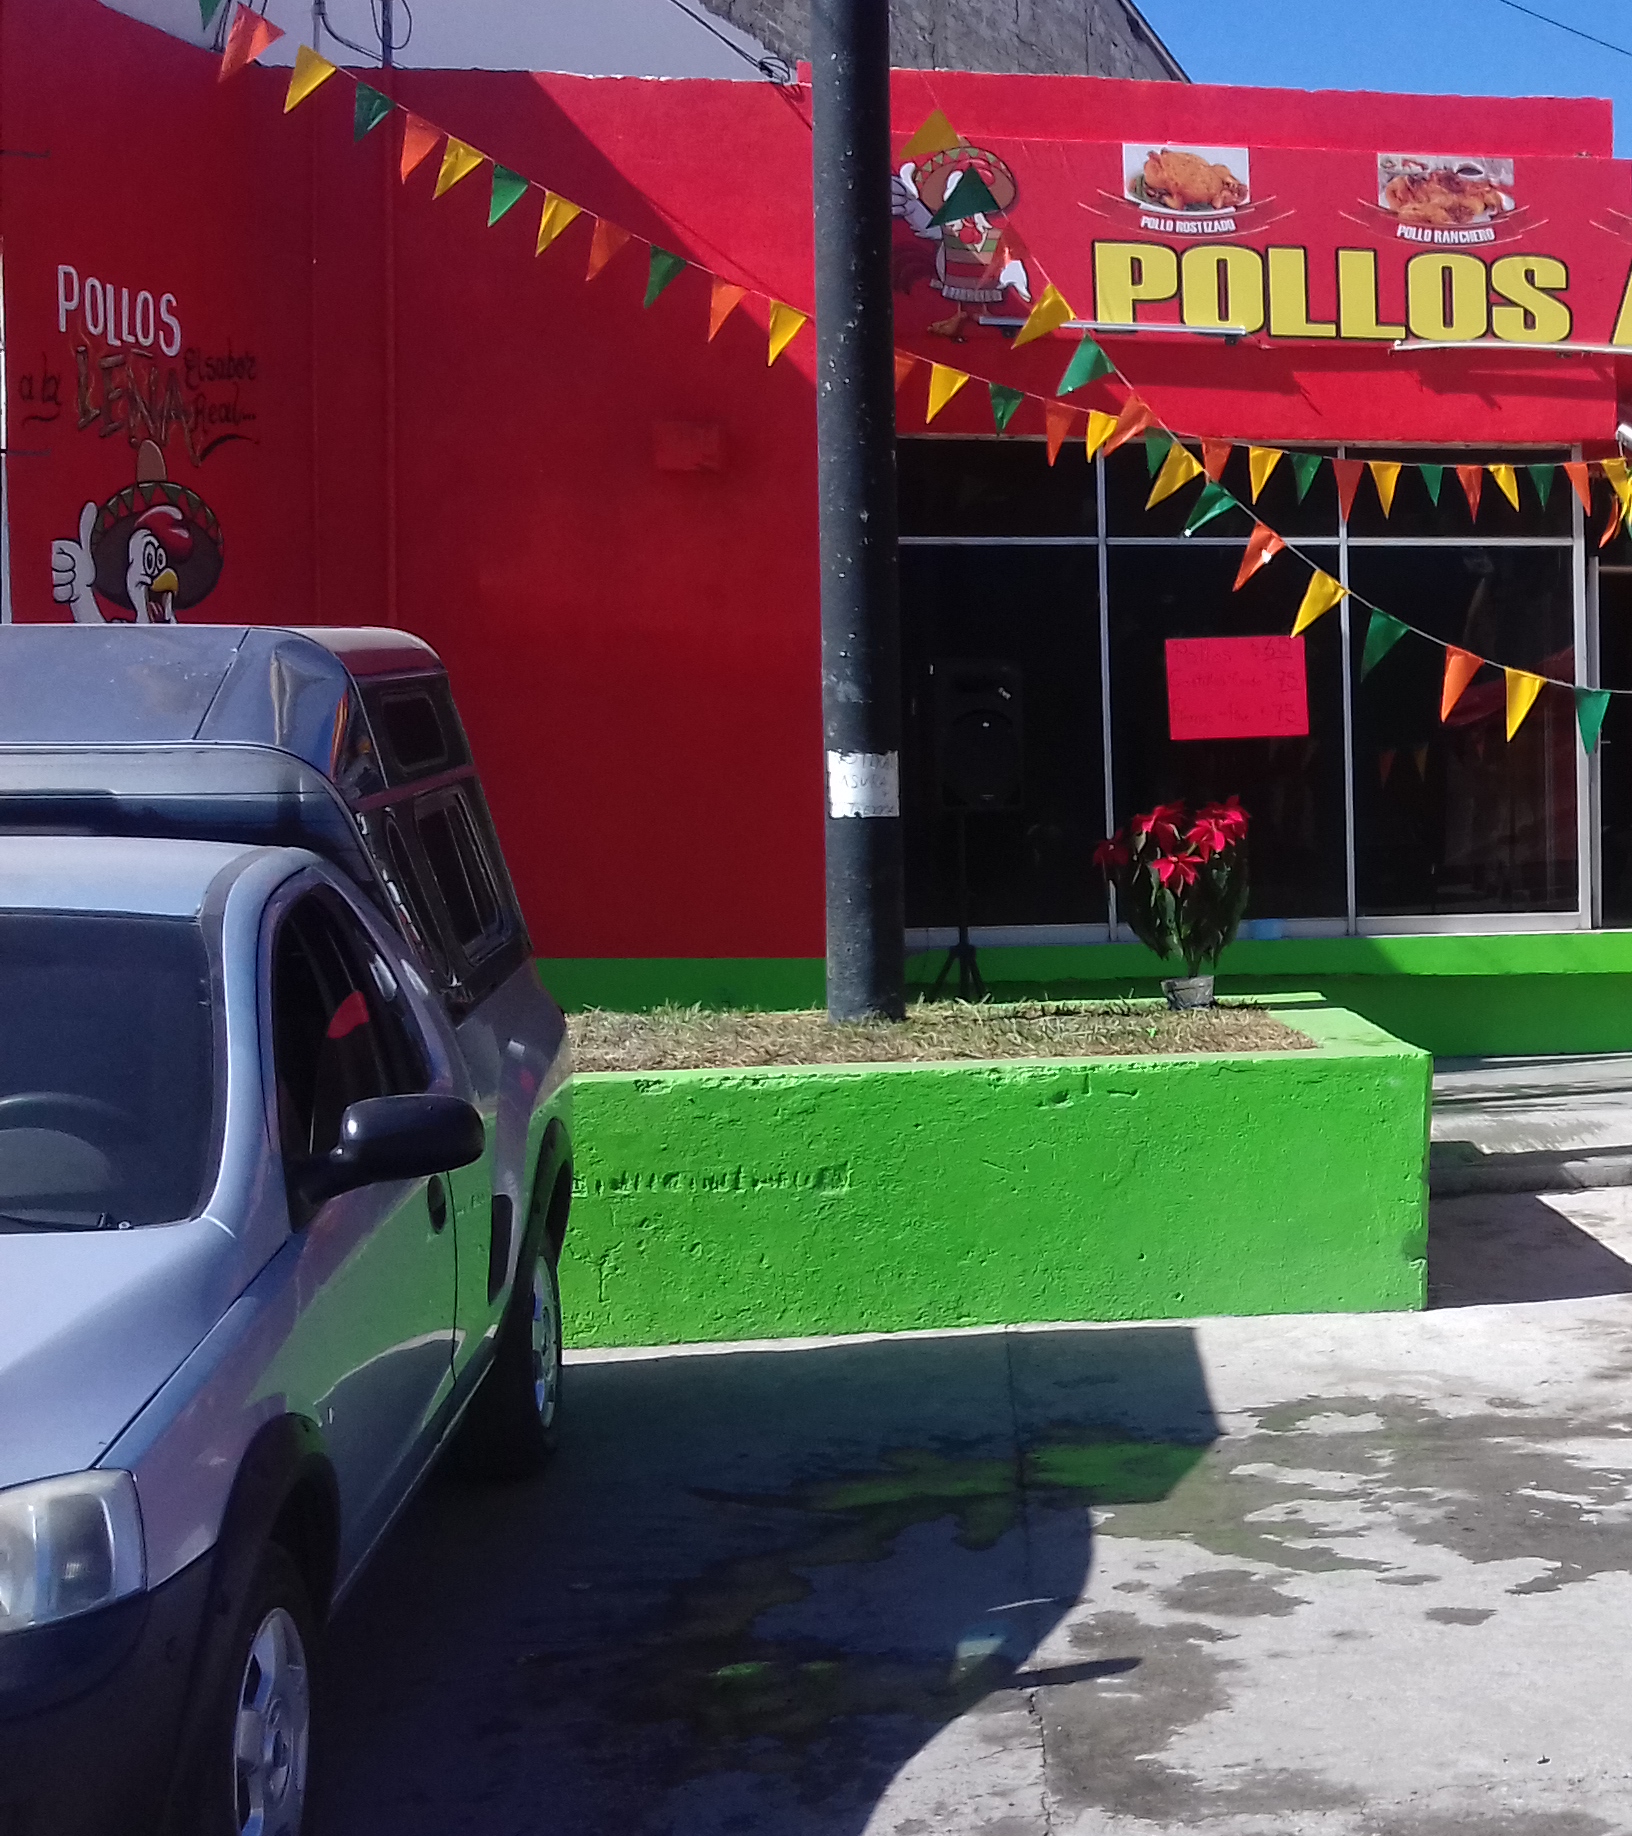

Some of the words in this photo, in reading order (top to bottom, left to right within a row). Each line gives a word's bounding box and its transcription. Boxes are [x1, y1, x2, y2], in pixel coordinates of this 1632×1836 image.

[1140, 215, 1174, 232] POLLO
[1175, 219, 1237, 233] ROSTIZADO
[1396, 223, 1432, 242] POLLO
[1433, 227, 1496, 244] RANCHERO
[56, 264, 182, 357] POLLOS
[1091, 240, 1573, 345] POLLOS
[75, 345, 202, 467] LEÑA
